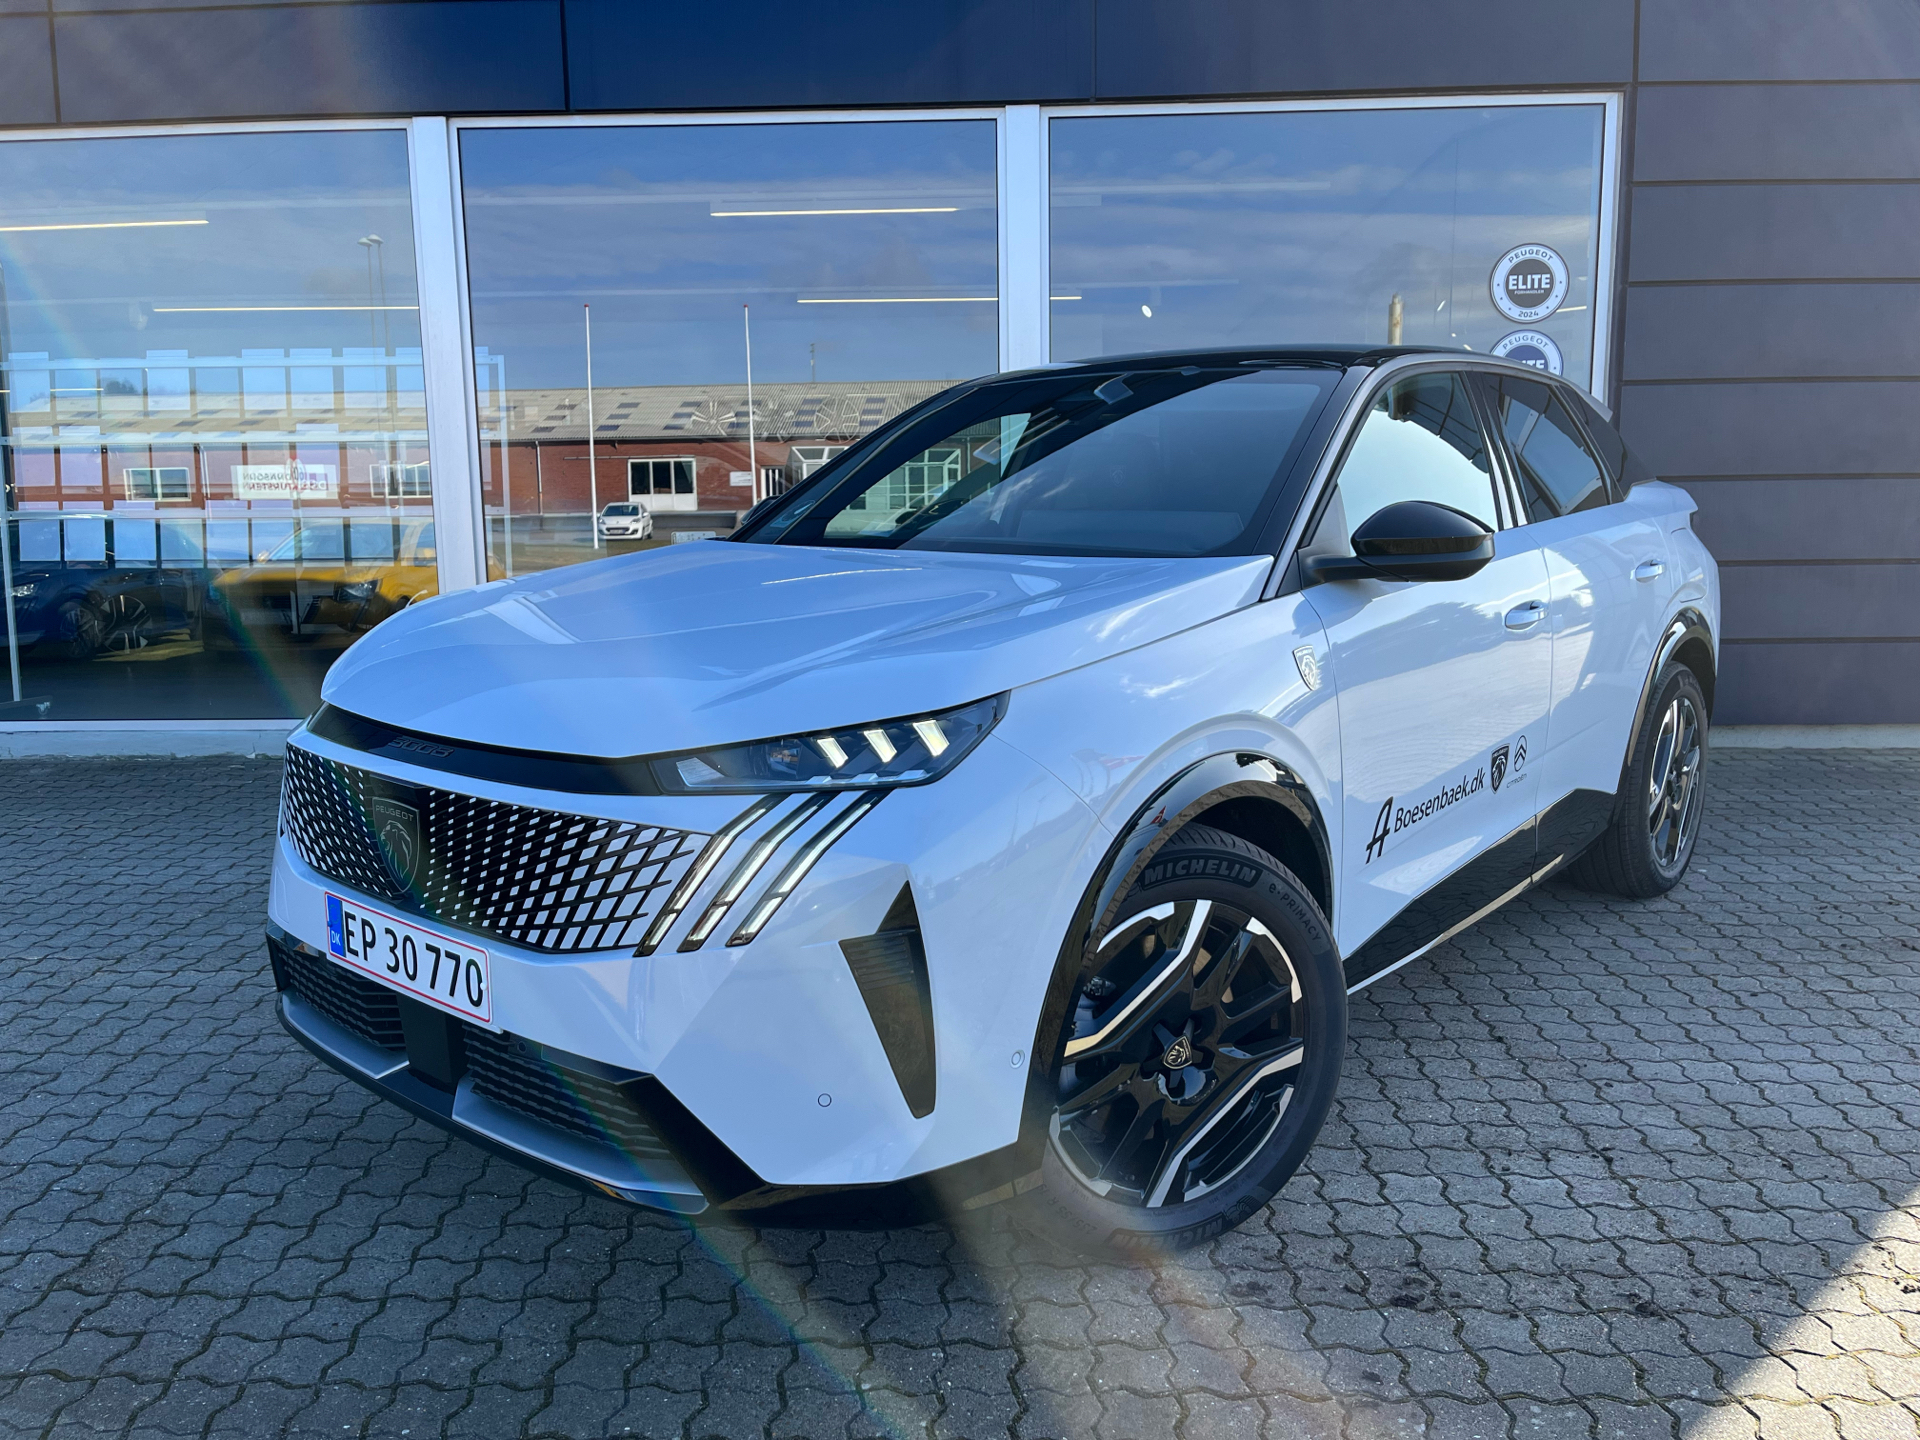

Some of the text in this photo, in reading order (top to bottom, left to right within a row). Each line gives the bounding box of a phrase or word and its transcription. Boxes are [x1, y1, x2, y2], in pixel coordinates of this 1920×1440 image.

[1508, 248, 1554, 263] PEUGEOT
[1508, 273, 1551, 290] ELITE
[1518, 310, 1539, 318] 2024
[1502, 334, 1549, 350] PEUGEOT
[388, 736, 455, 758] 3008
[1394, 767, 1486, 833] Boesenbaek.dk
[375, 804, 414, 822] PEUGEOT
[1144, 858, 1257, 884] MICHELIN
[331, 930, 341, 946] DK
[344, 910, 484, 1008] EP 30 770
[1110, 1218, 1223, 1250] MICHELIN
